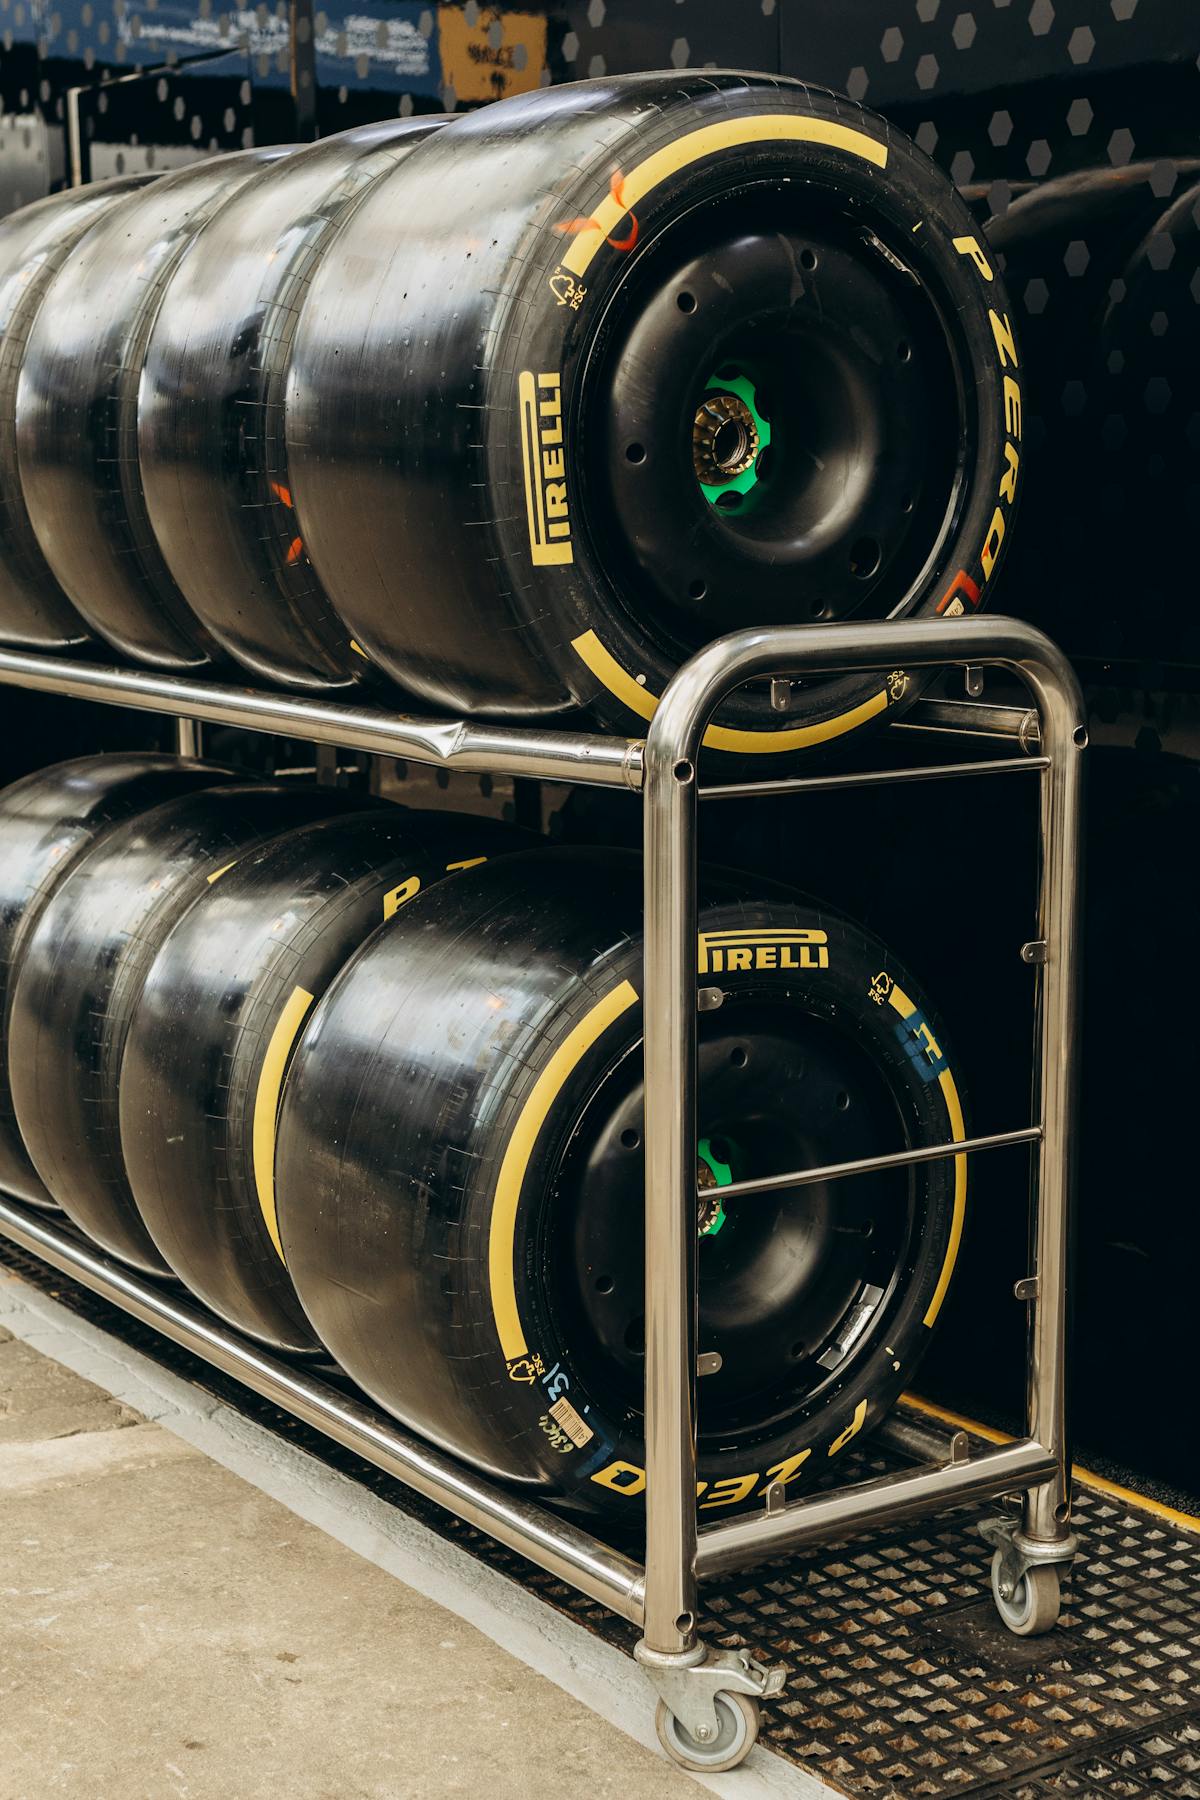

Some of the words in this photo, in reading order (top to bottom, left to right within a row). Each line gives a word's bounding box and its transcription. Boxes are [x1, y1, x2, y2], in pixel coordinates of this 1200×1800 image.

[569, 284, 588, 311] FSC
[953, 236, 994, 282] P
[981, 308, 1022, 583] ZERO
[519, 371, 573, 566] PIRELLI
[698, 928, 829, 974] PIRELLI
[867, 987, 885, 1006] FSC
[532, 1353, 546, 1376] FSC
